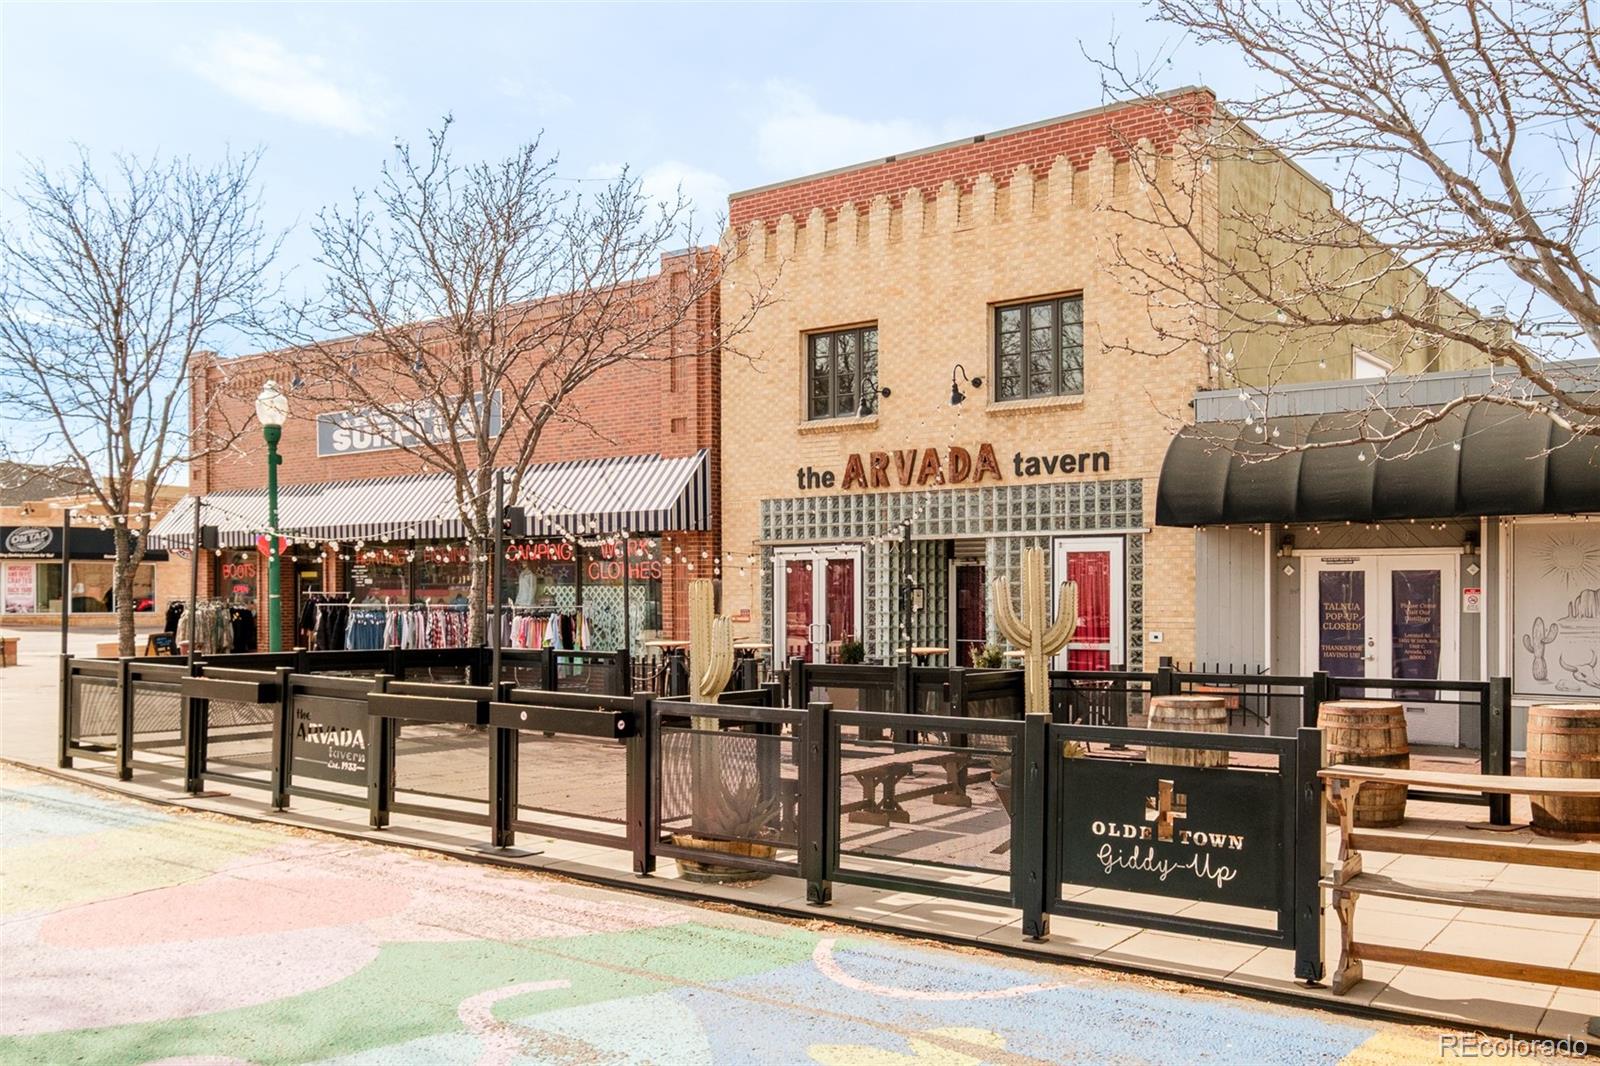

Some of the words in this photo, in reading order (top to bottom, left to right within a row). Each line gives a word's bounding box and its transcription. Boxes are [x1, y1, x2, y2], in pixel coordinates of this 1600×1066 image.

[798, 466, 835, 490] the
[841, 443, 1003, 489] ARVADA
[1013, 451, 1110, 477] tavern
[506, 543, 573, 561] CAMPING
[600, 538, 651, 561] WORK
[222, 563, 256, 579] BOOTS
[1323, 602, 1361, 611] TALNUA
[1325, 612, 1359, 621] POP-UP
[1322, 622, 1362, 631] CLOSED!
[296, 708, 311, 720] the
[297, 723, 365, 750] ARVADA
[328, 746, 365, 763] tavern
[1092, 821, 1152, 840] OLDE
[1179, 830, 1244, 850] TOWN
[1097, 843, 1237, 888] Giddy-Up
